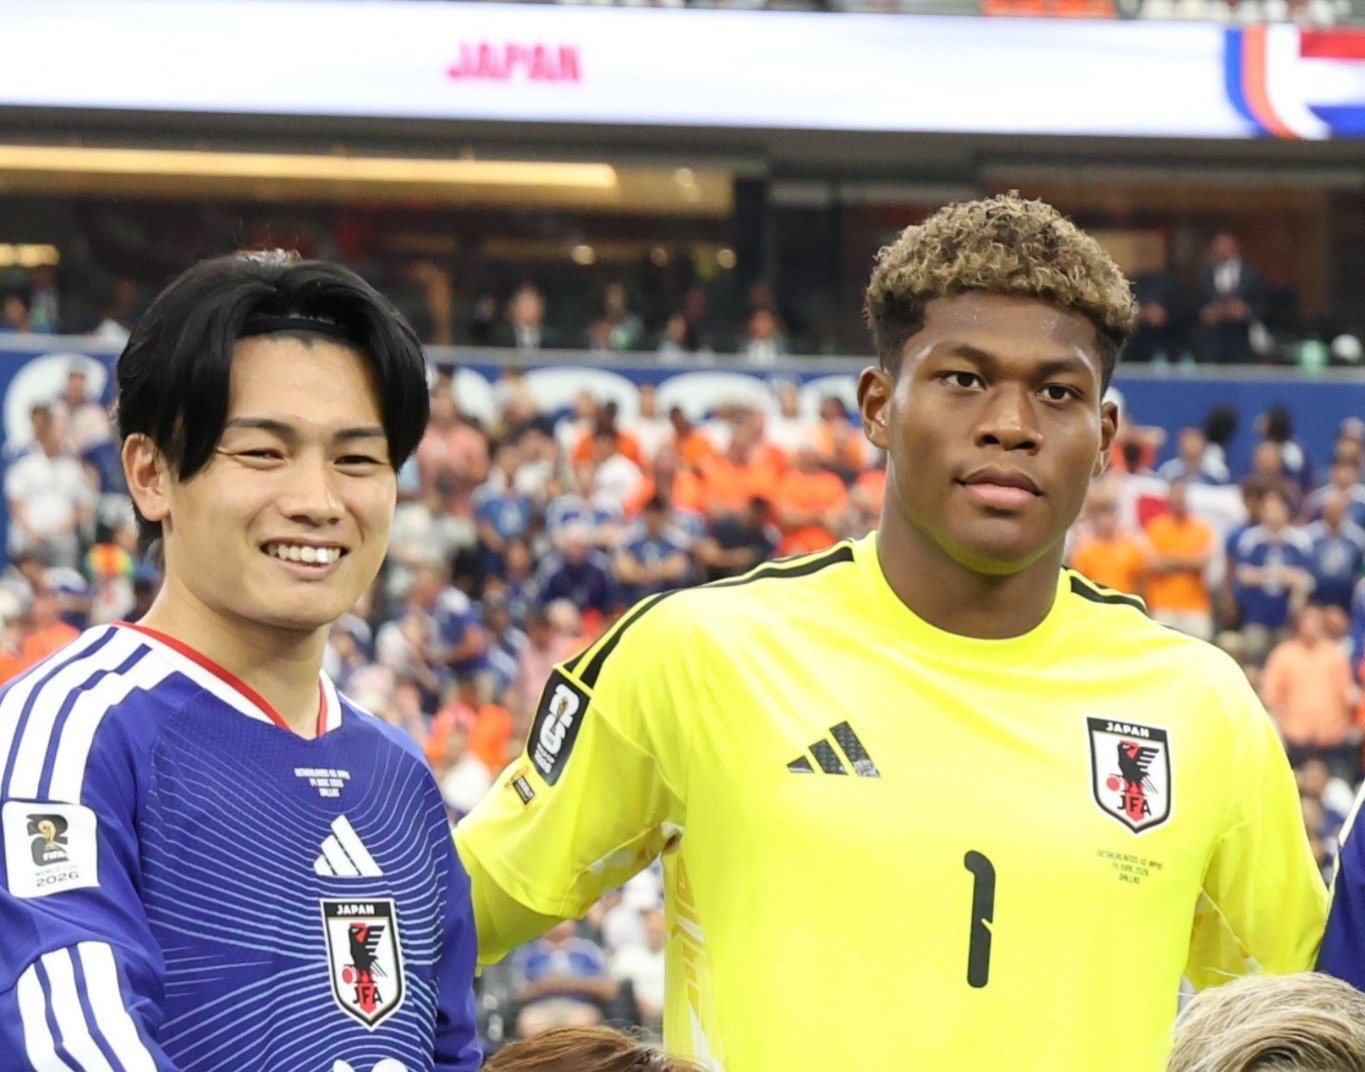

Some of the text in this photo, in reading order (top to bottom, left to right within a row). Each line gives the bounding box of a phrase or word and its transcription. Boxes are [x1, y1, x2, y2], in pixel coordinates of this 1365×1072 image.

[446, 42, 581, 82] JAPAN
[1106, 721, 1150, 738] JAPAN
[1117, 794, 1152, 816] JFA
[37, 871, 79, 888] 2026
[336, 904, 375, 915] JAPAN
[963, 850, 996, 988] 1
[352, 986, 383, 1004] JFA
